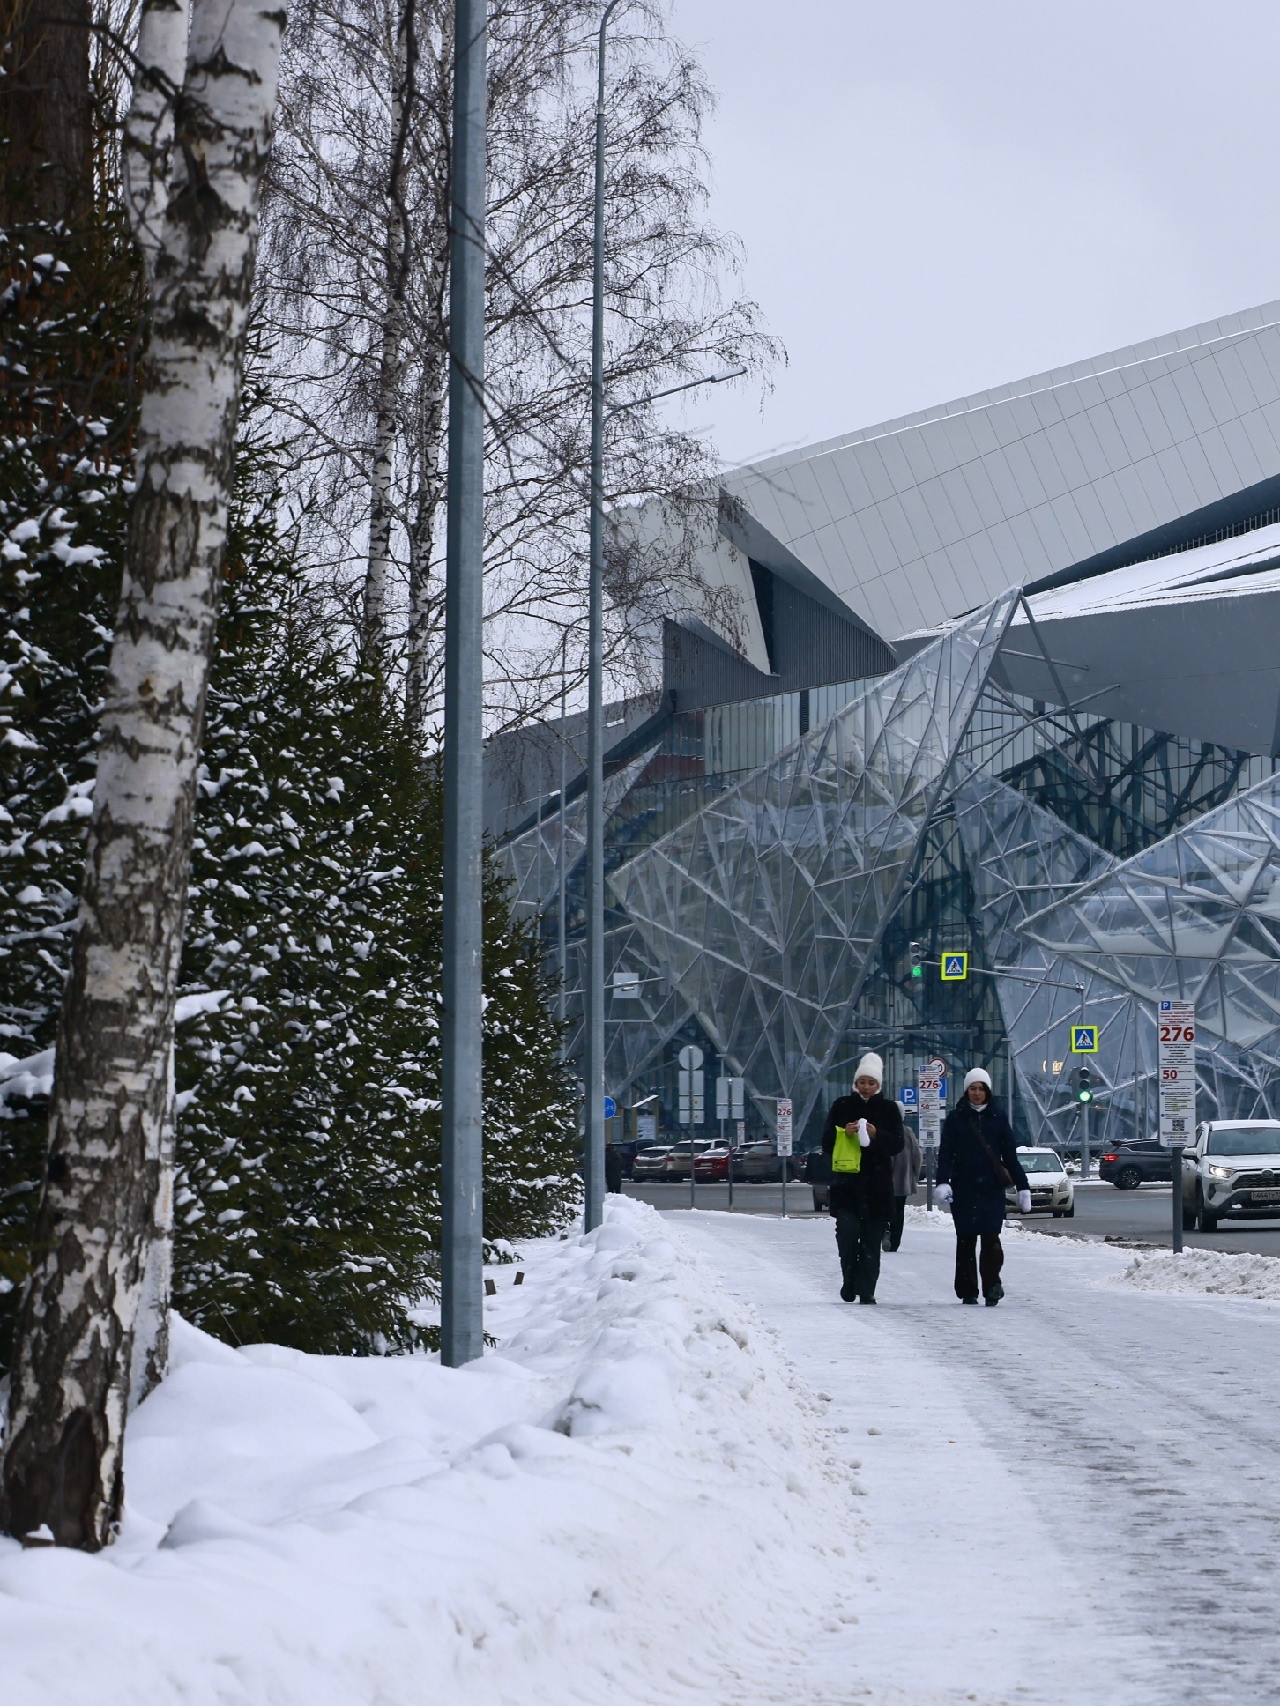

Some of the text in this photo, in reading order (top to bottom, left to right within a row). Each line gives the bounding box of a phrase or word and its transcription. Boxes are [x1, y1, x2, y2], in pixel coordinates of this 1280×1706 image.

[1160, 1026, 1195, 1042] 276
[1163, 1070, 1178, 1080] 50
[920, 1080, 939, 1089] 276
[903, 1088, 914, 1103] P
[777, 1108, 792, 1116] 276
